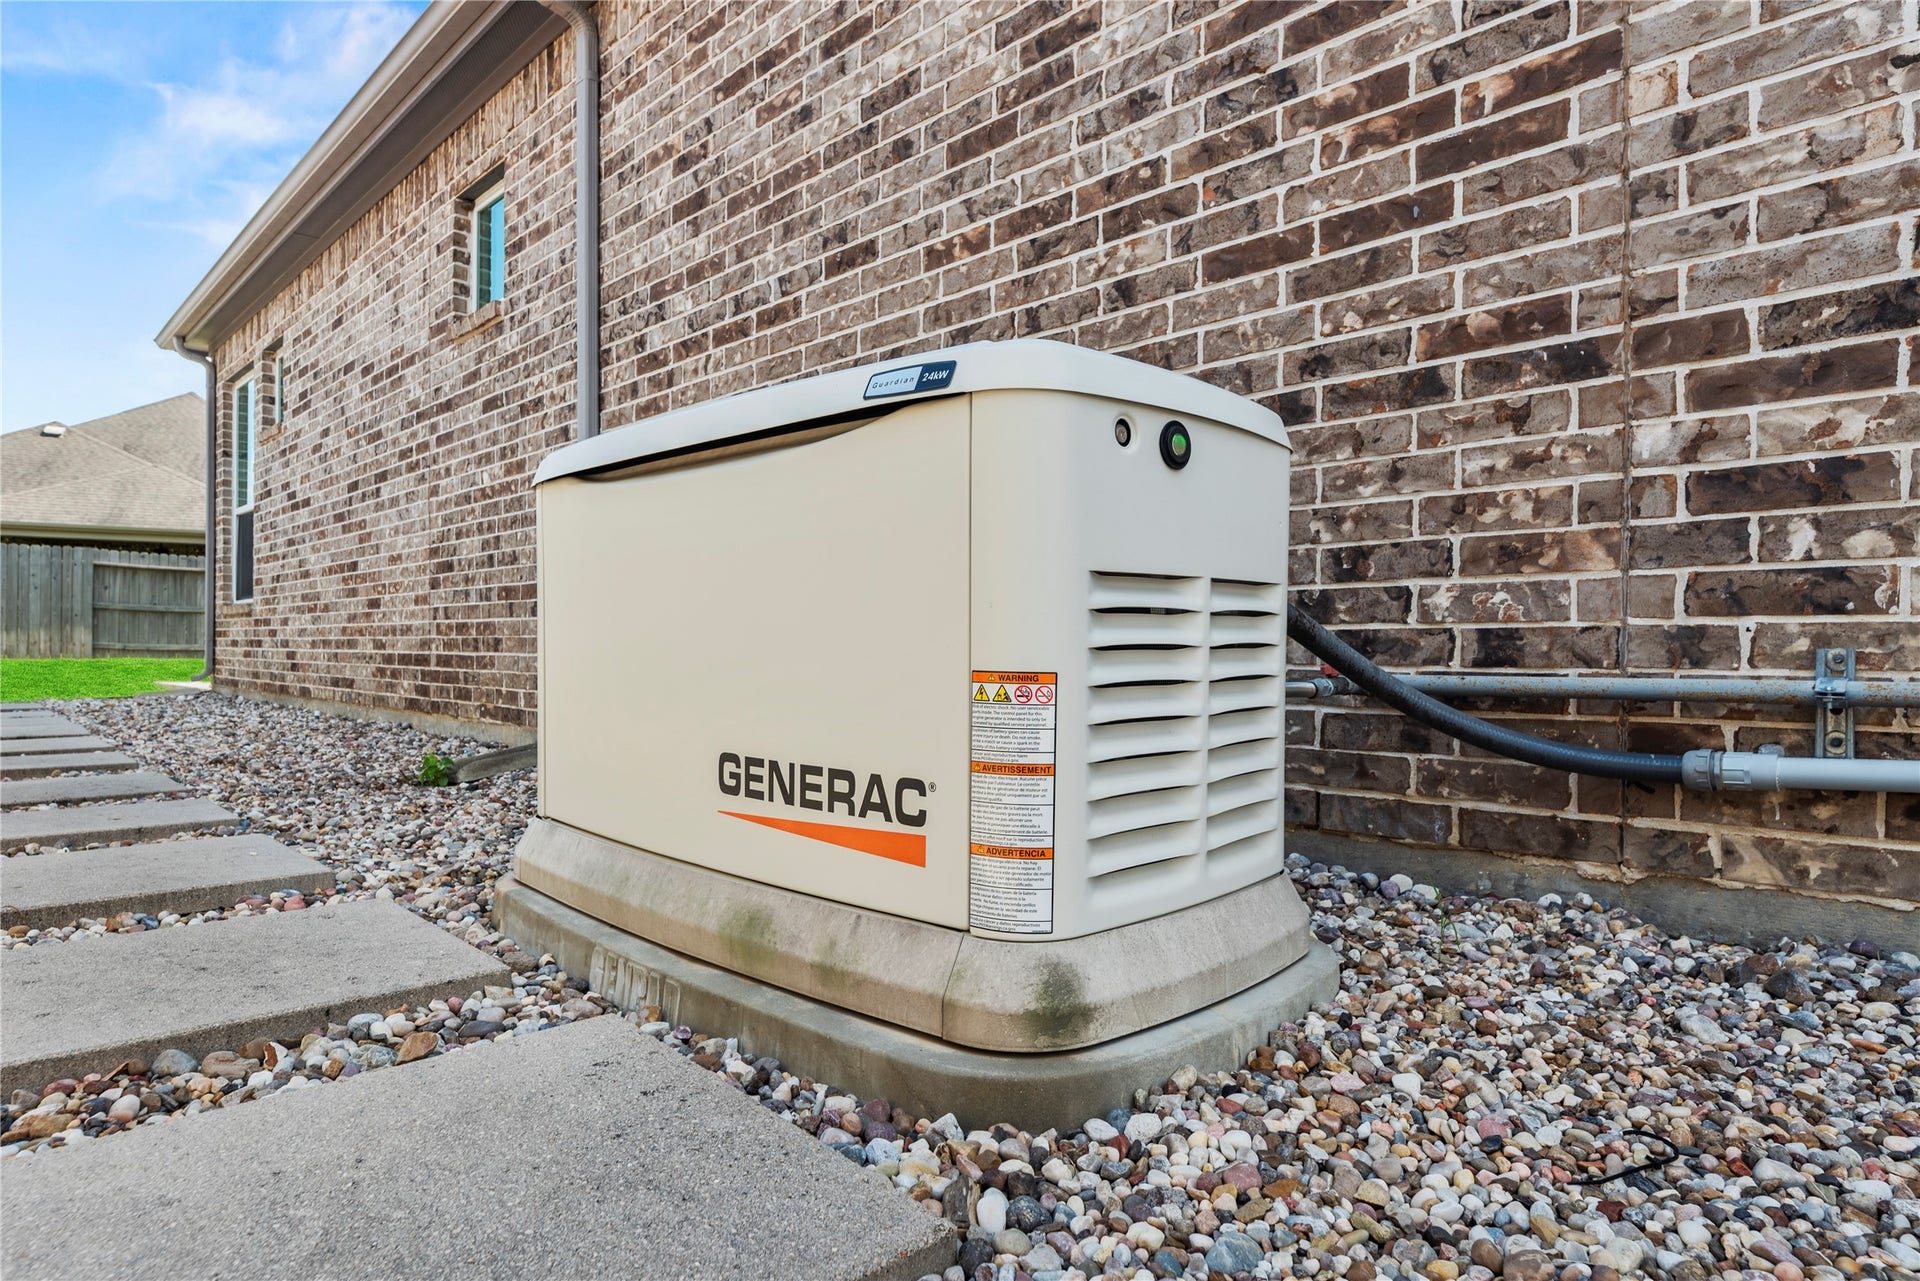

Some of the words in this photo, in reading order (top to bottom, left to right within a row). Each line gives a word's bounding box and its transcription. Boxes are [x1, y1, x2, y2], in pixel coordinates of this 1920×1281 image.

[872, 376, 915, 389] Guardian
[922, 370, 950, 382] 24kW
[998, 674, 1039, 682] WARNING
[982, 764, 1052, 774] AVERTISSEMENT
[986, 847, 1046, 857] ADVERTENCIA
